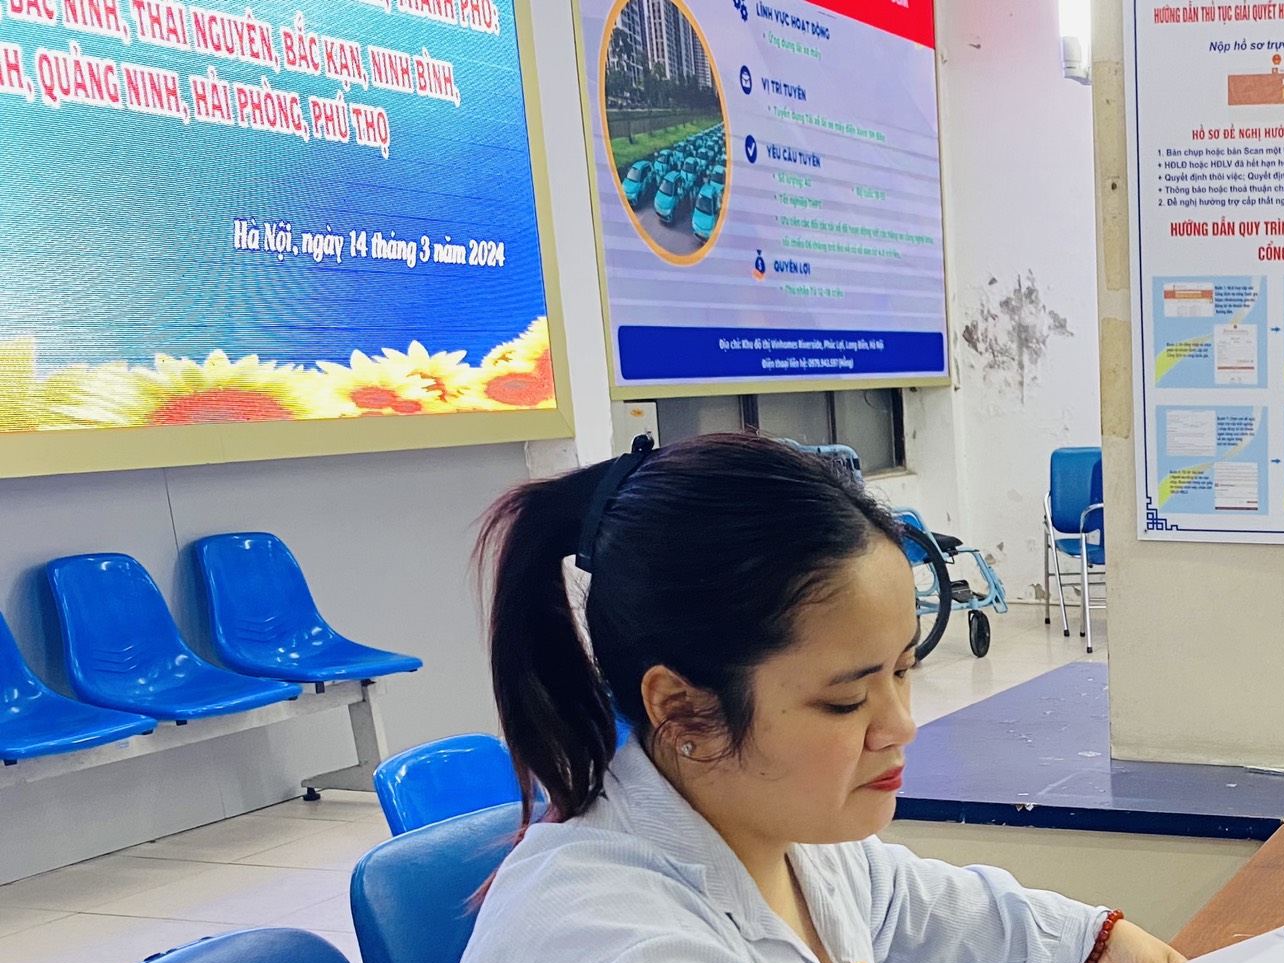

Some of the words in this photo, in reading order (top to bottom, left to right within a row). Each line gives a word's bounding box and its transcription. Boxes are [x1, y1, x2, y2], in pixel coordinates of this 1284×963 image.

[192, 11, 280, 67] NGUYÊN,
[282, 14, 320, 72] BẮC
[323, 39, 368, 89] KẠN,
[370, 49, 413, 89] NINH
[414, 50, 459, 101] BÌNH,
[1209, 41, 1231, 53] Nộp
[1233, 37, 1248, 51] hồ
[1250, 41, 1265, 50] sơ
[0, 48, 32, 93] H,
[38, 43, 120, 103] QUẢNG
[124, 67, 188, 119] NINH,
[192, 69, 232, 121] HẢI
[236, 79, 308, 135] PHÒNG,
[310, 93, 349, 139] PHÚ
[352, 107, 389, 154] THỌ
[233, 217, 259, 250] Hà
[263, 221, 299, 261] Nội,
[301, 223, 344, 264] ngày
[349, 229, 369, 258] 14
[371, 230, 417, 269] tháng
[419, 235, 431, 263] 3
[433, 235, 467, 265] năm
[468, 239, 506, 268] 2024
[1170, 218, 1209, 237] HƯỚNG
[1211, 215, 1236, 236] DẪN
[1238, 221, 1260, 237] QUY
